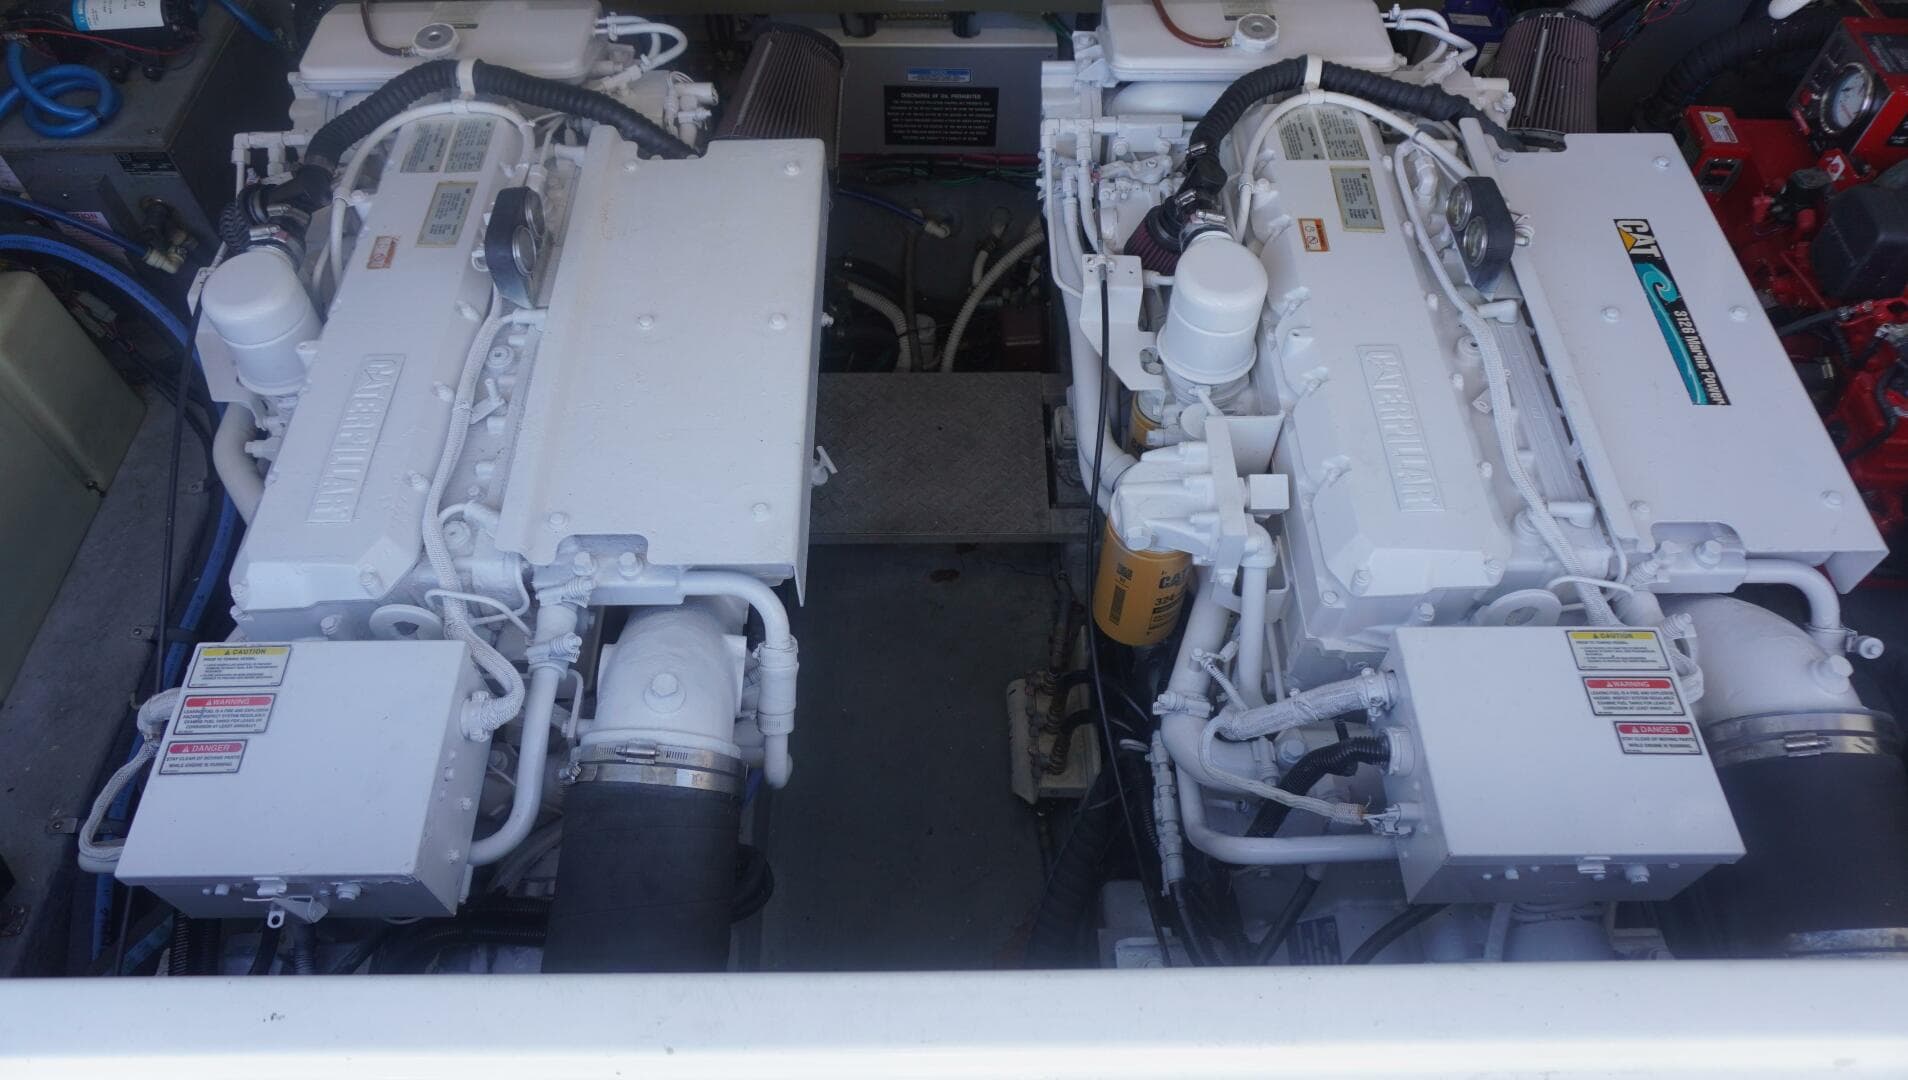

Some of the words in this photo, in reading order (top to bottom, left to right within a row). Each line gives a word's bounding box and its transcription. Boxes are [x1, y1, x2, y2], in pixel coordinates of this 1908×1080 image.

[1615, 219, 1663, 260] CAT
[1673, 309, 1696, 334] 3126
[1684, 334, 1710, 370] Marine
[1700, 370, 1727, 405] Power
[313, 359, 397, 521] CATERPILLAR
[1366, 350, 1440, 510] CATERPILLAR
[212, 698, 250, 706] WARNING
[191, 744, 230, 752] DANGER
